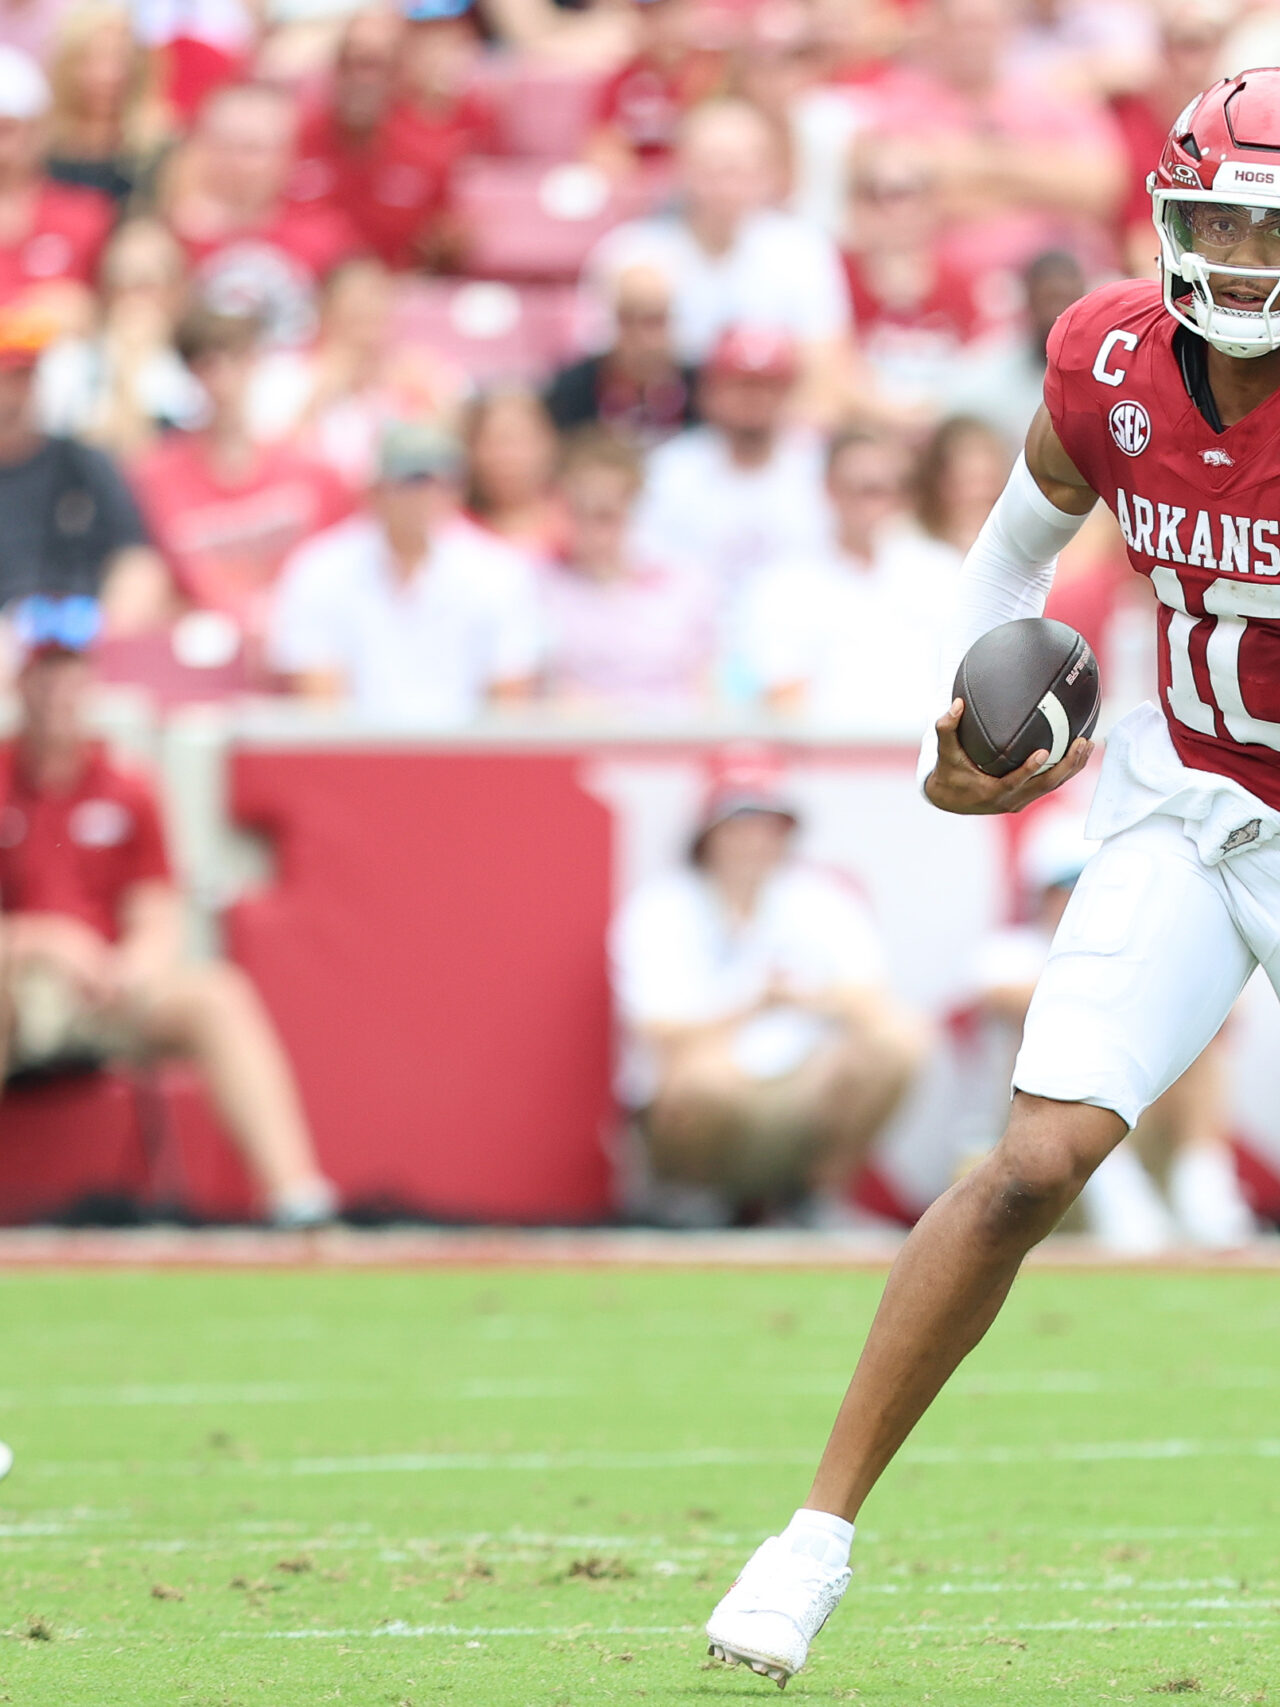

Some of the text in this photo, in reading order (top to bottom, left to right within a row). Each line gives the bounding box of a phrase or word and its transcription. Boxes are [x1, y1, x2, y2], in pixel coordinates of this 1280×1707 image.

[1234, 170, 1274, 184] HOGS
[1092, 329, 1138, 387] C
[1112, 404, 1147, 453] SEC
